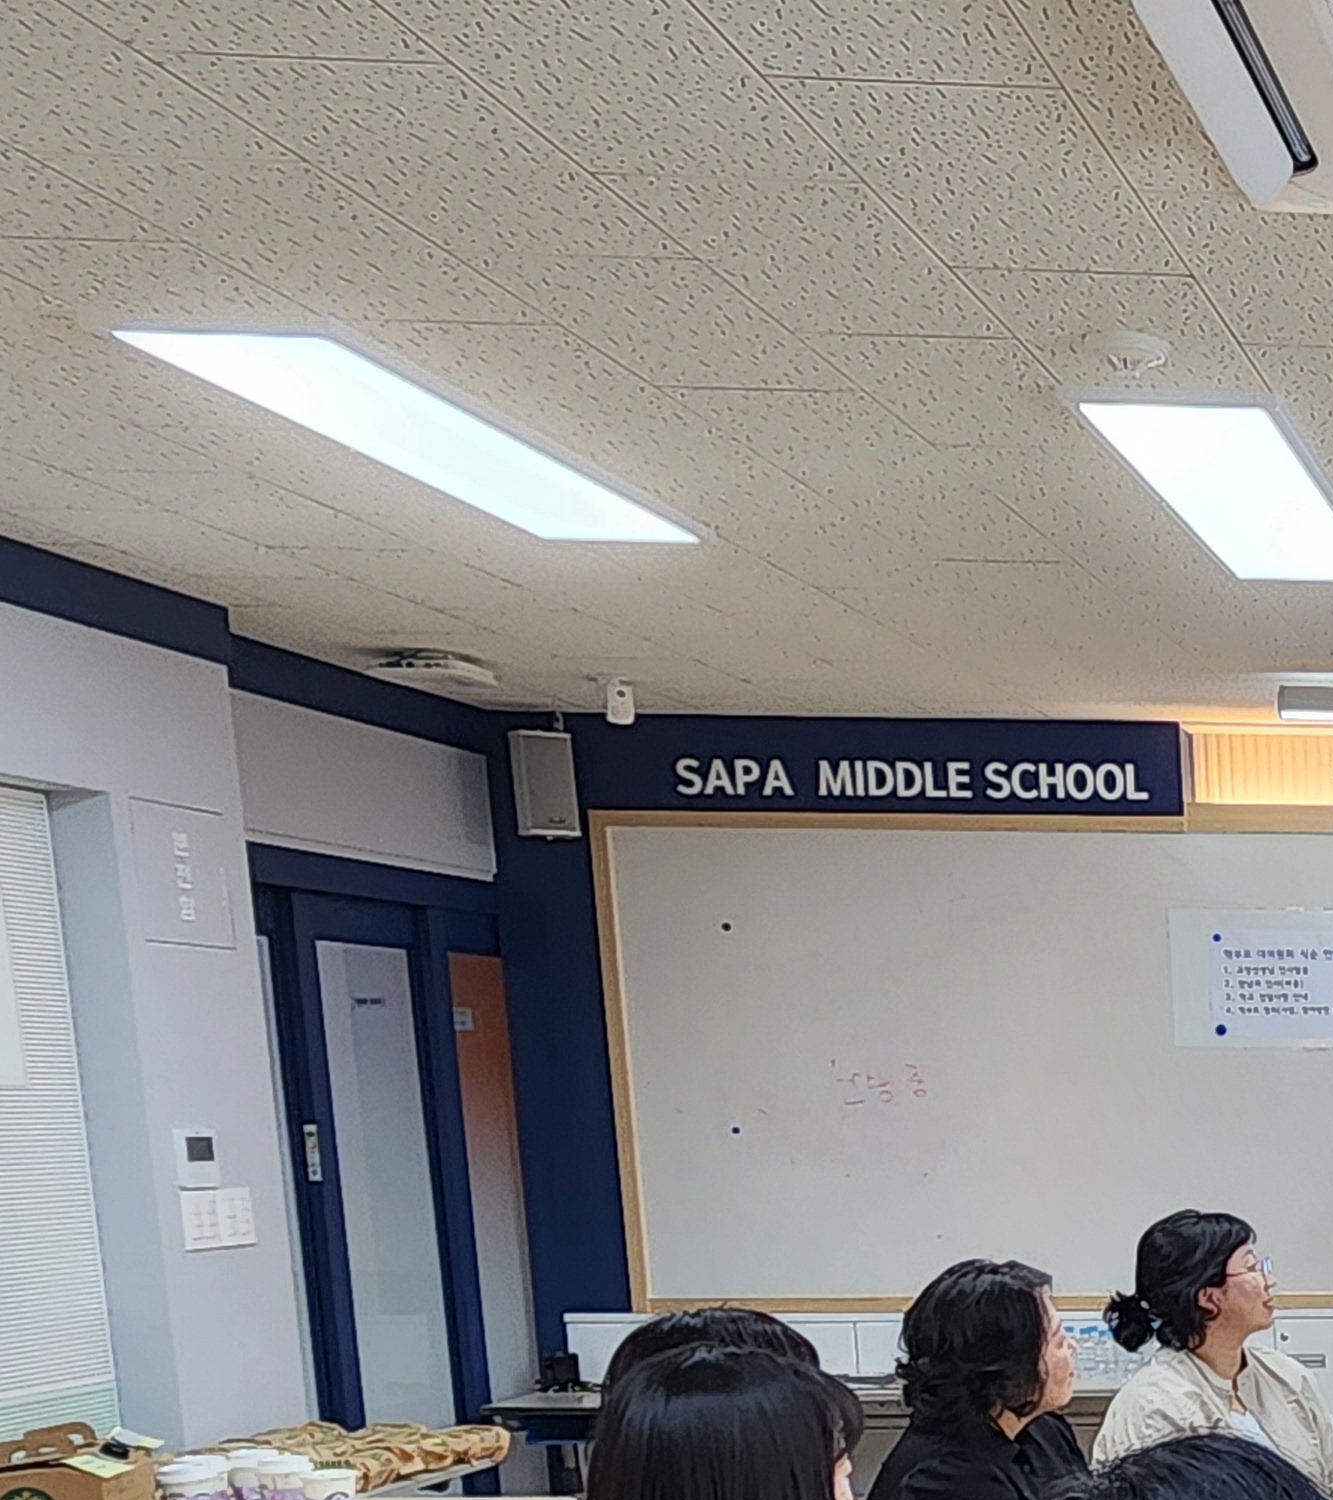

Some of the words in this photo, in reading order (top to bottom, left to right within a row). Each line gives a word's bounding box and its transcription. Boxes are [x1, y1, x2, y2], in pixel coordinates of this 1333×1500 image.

[675, 757, 795, 796] SAPA
[818, 760, 973, 799] MIDDLE
[985, 762, 1149, 801] SCHOOL
